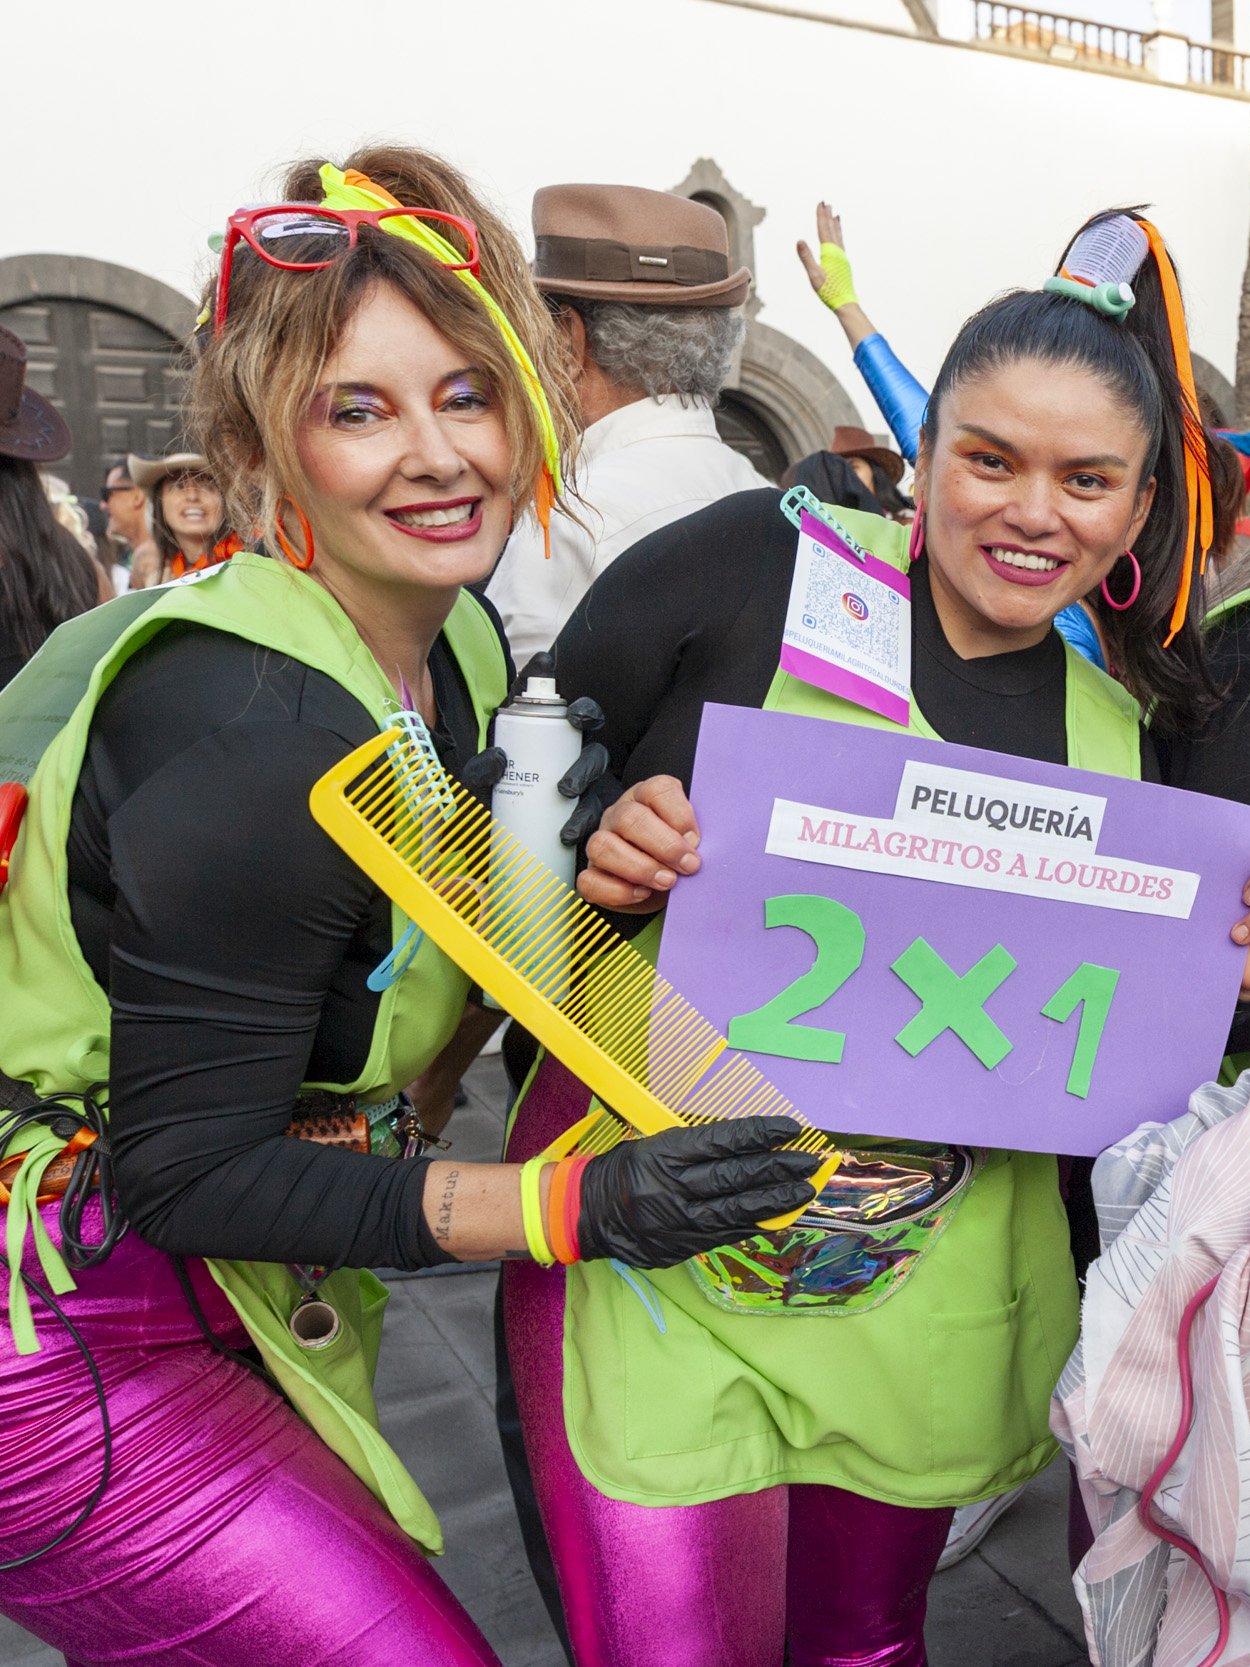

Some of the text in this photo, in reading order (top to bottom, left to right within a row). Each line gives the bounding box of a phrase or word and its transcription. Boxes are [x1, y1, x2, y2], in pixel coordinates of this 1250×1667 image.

[910, 784, 1093, 841] PELUQUERÍA
[797, 816, 1174, 901] MILAGRITOS A LOURDES
[436, 1169, 460, 1242] Maktub
